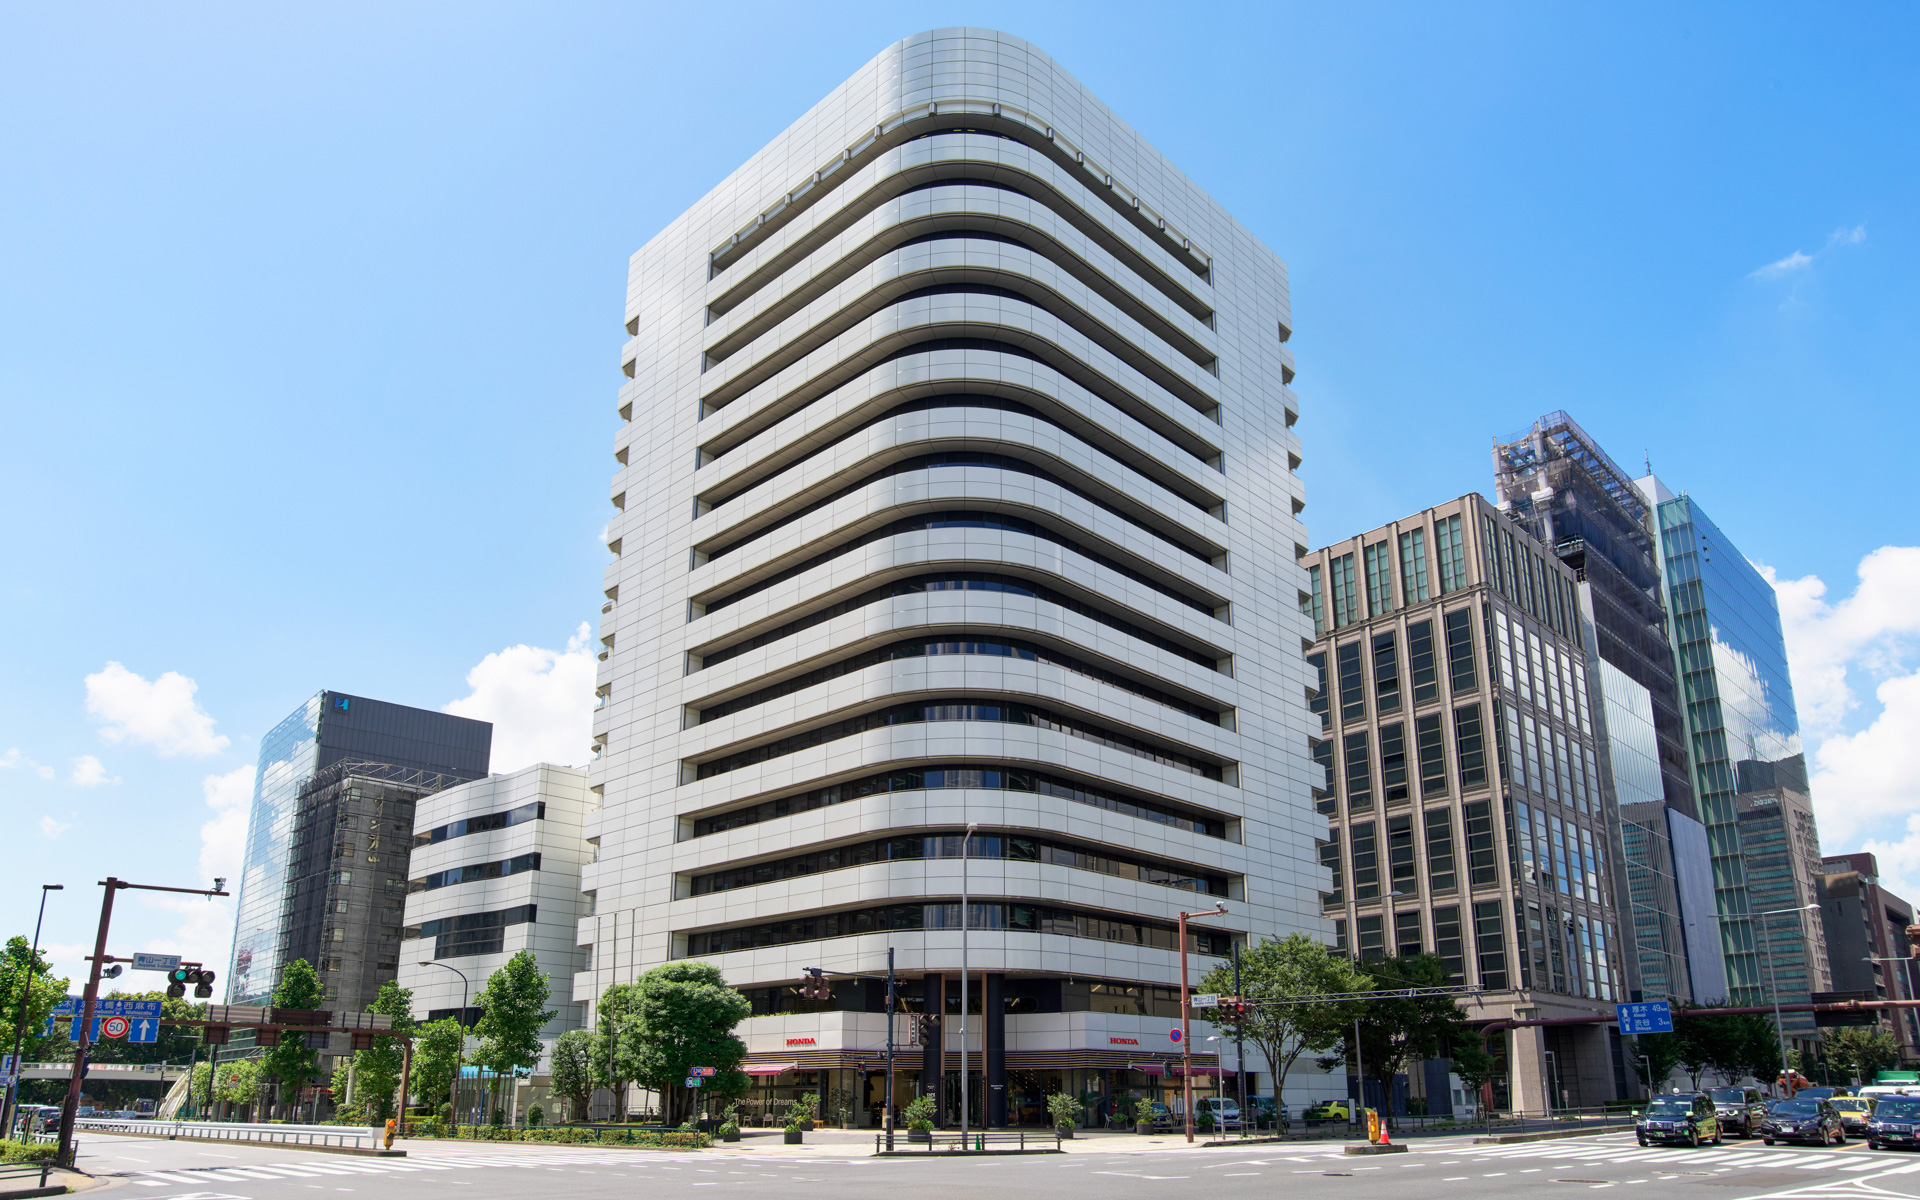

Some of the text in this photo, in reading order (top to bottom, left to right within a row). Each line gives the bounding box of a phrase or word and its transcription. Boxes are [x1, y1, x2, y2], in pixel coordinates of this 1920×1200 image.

[138, 956, 178, 965] 青山一丁目
[123, 1002, 157, 1010] 西麻布
[109, 1023, 123, 1032] 50
[786, 1038, 816, 1046] HONDA
[1109, 1037, 1139, 1045] HONDA
[746, 1098, 764, 1106] Power
[774, 1098, 798, 1106] Dreams
